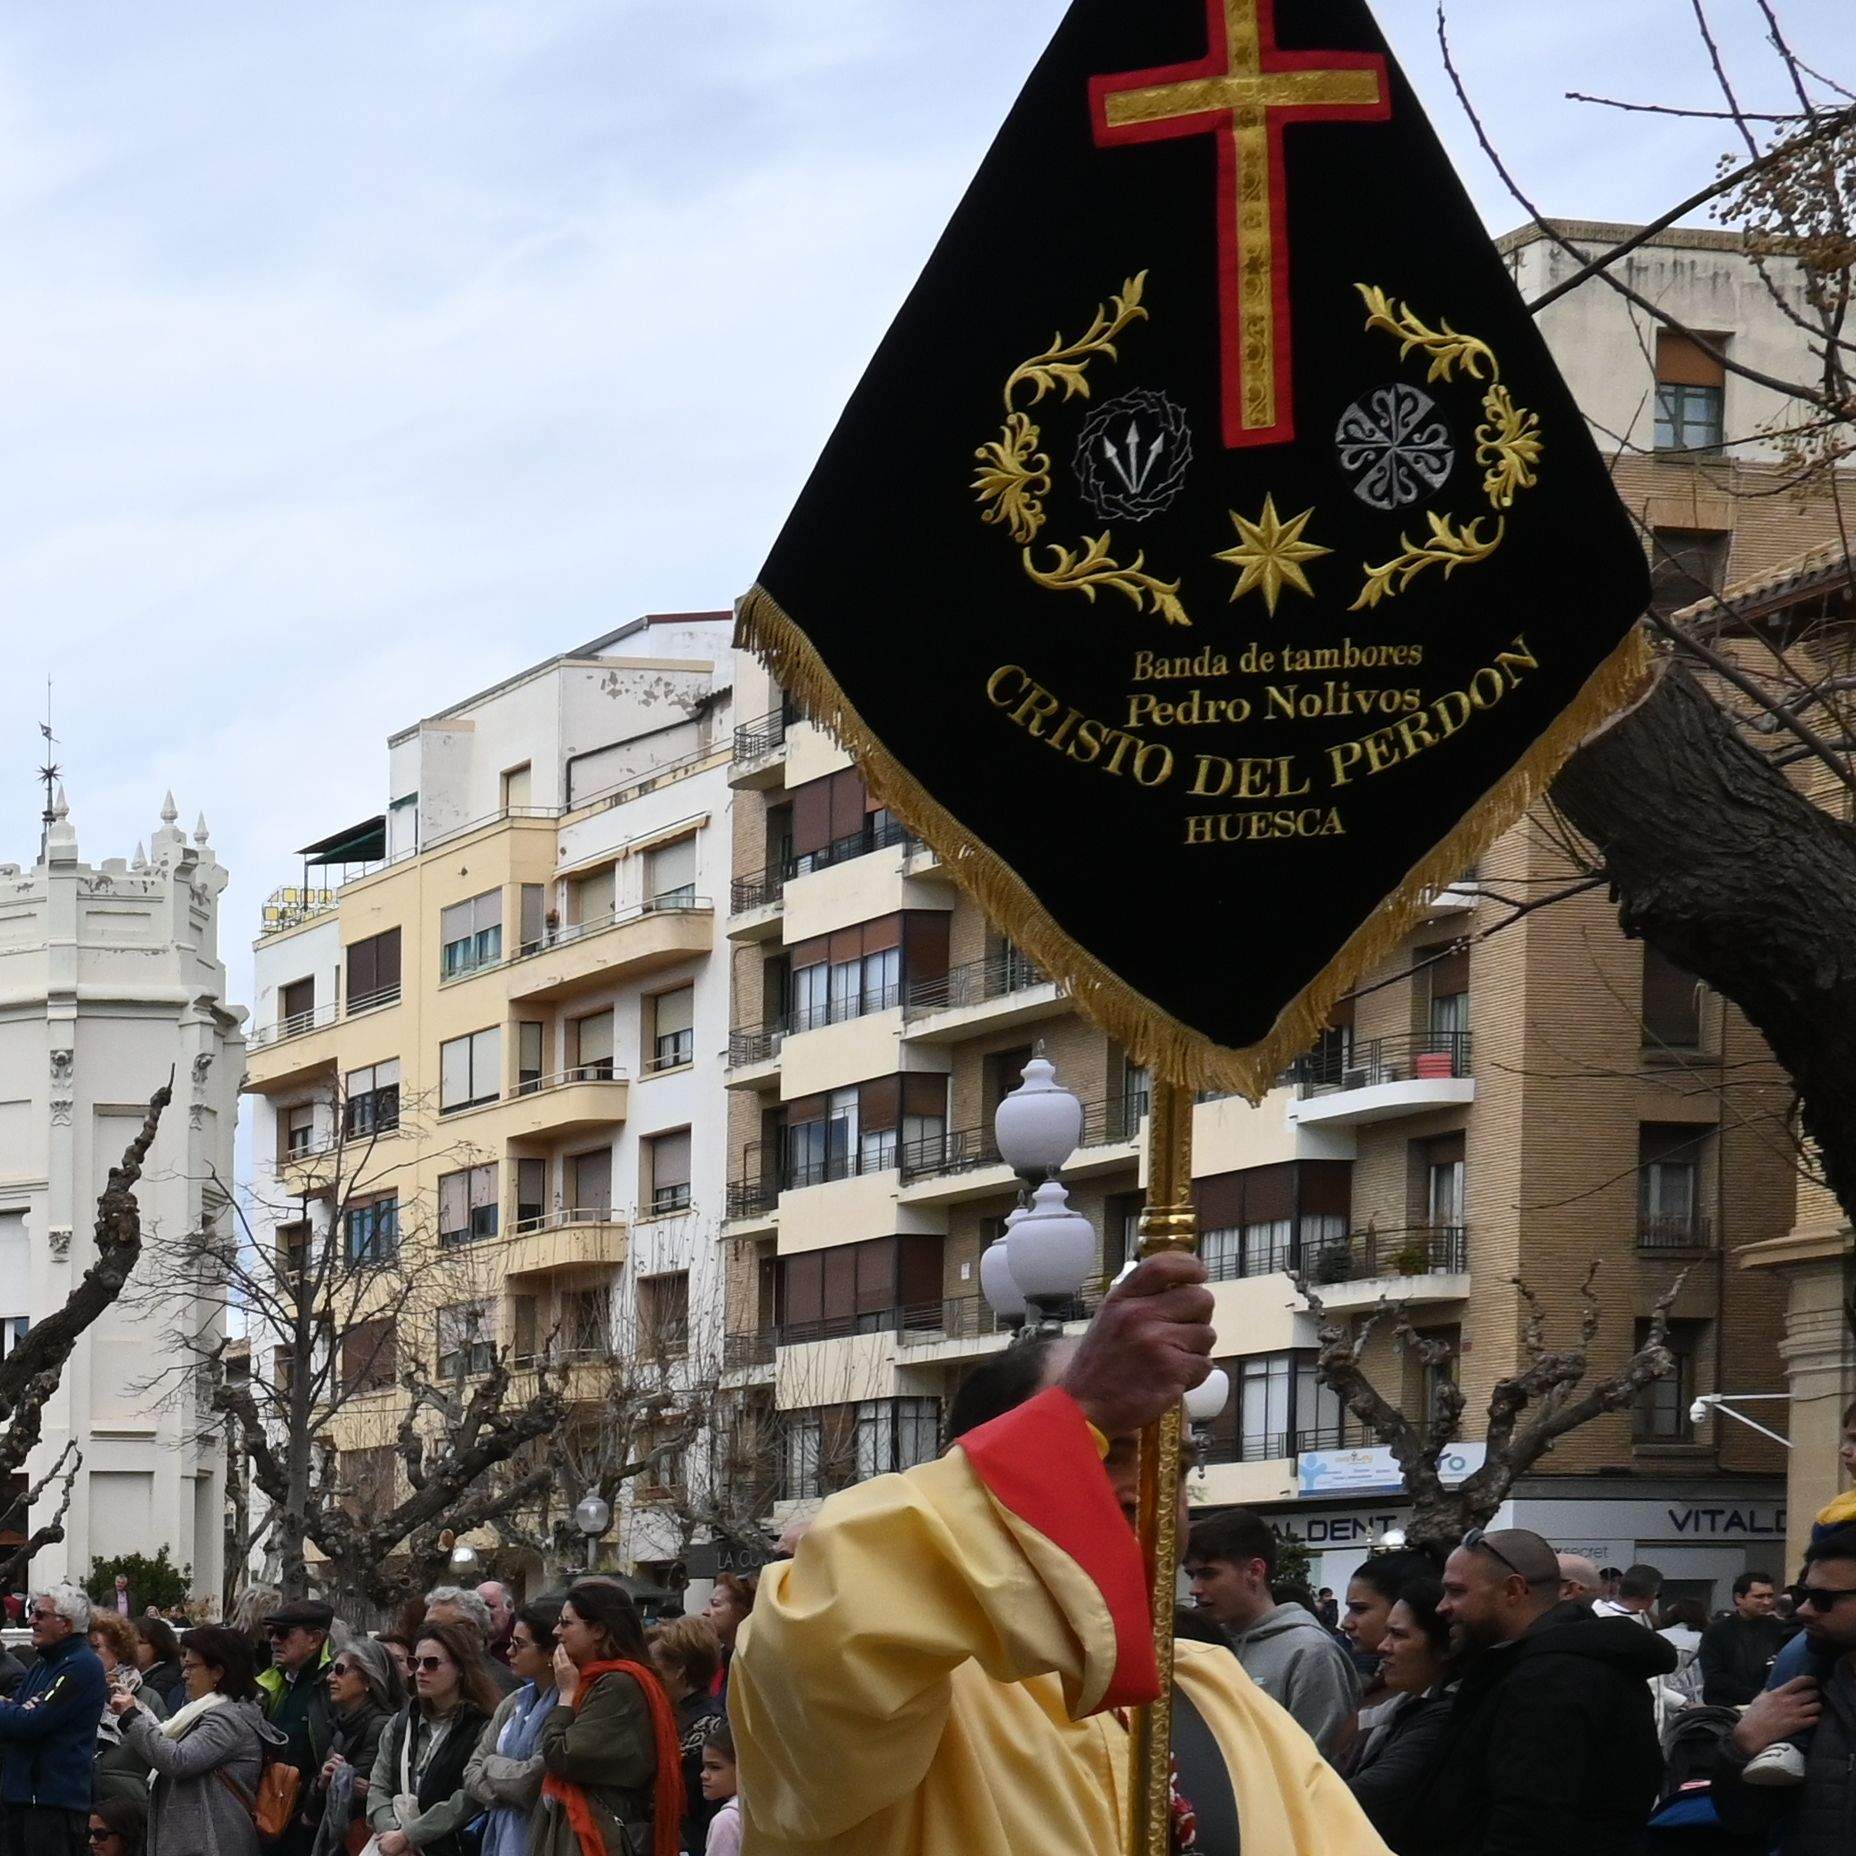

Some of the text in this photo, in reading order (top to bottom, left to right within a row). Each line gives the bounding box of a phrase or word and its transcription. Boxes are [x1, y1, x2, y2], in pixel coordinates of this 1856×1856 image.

[1132, 637, 1424, 681] Banda de tambores
[986, 632, 1539, 798] CRISTO DEL PERDON
[1123, 680, 1422, 728] Pedro Nolivos
[1183, 807, 1347, 844] HUESCA
